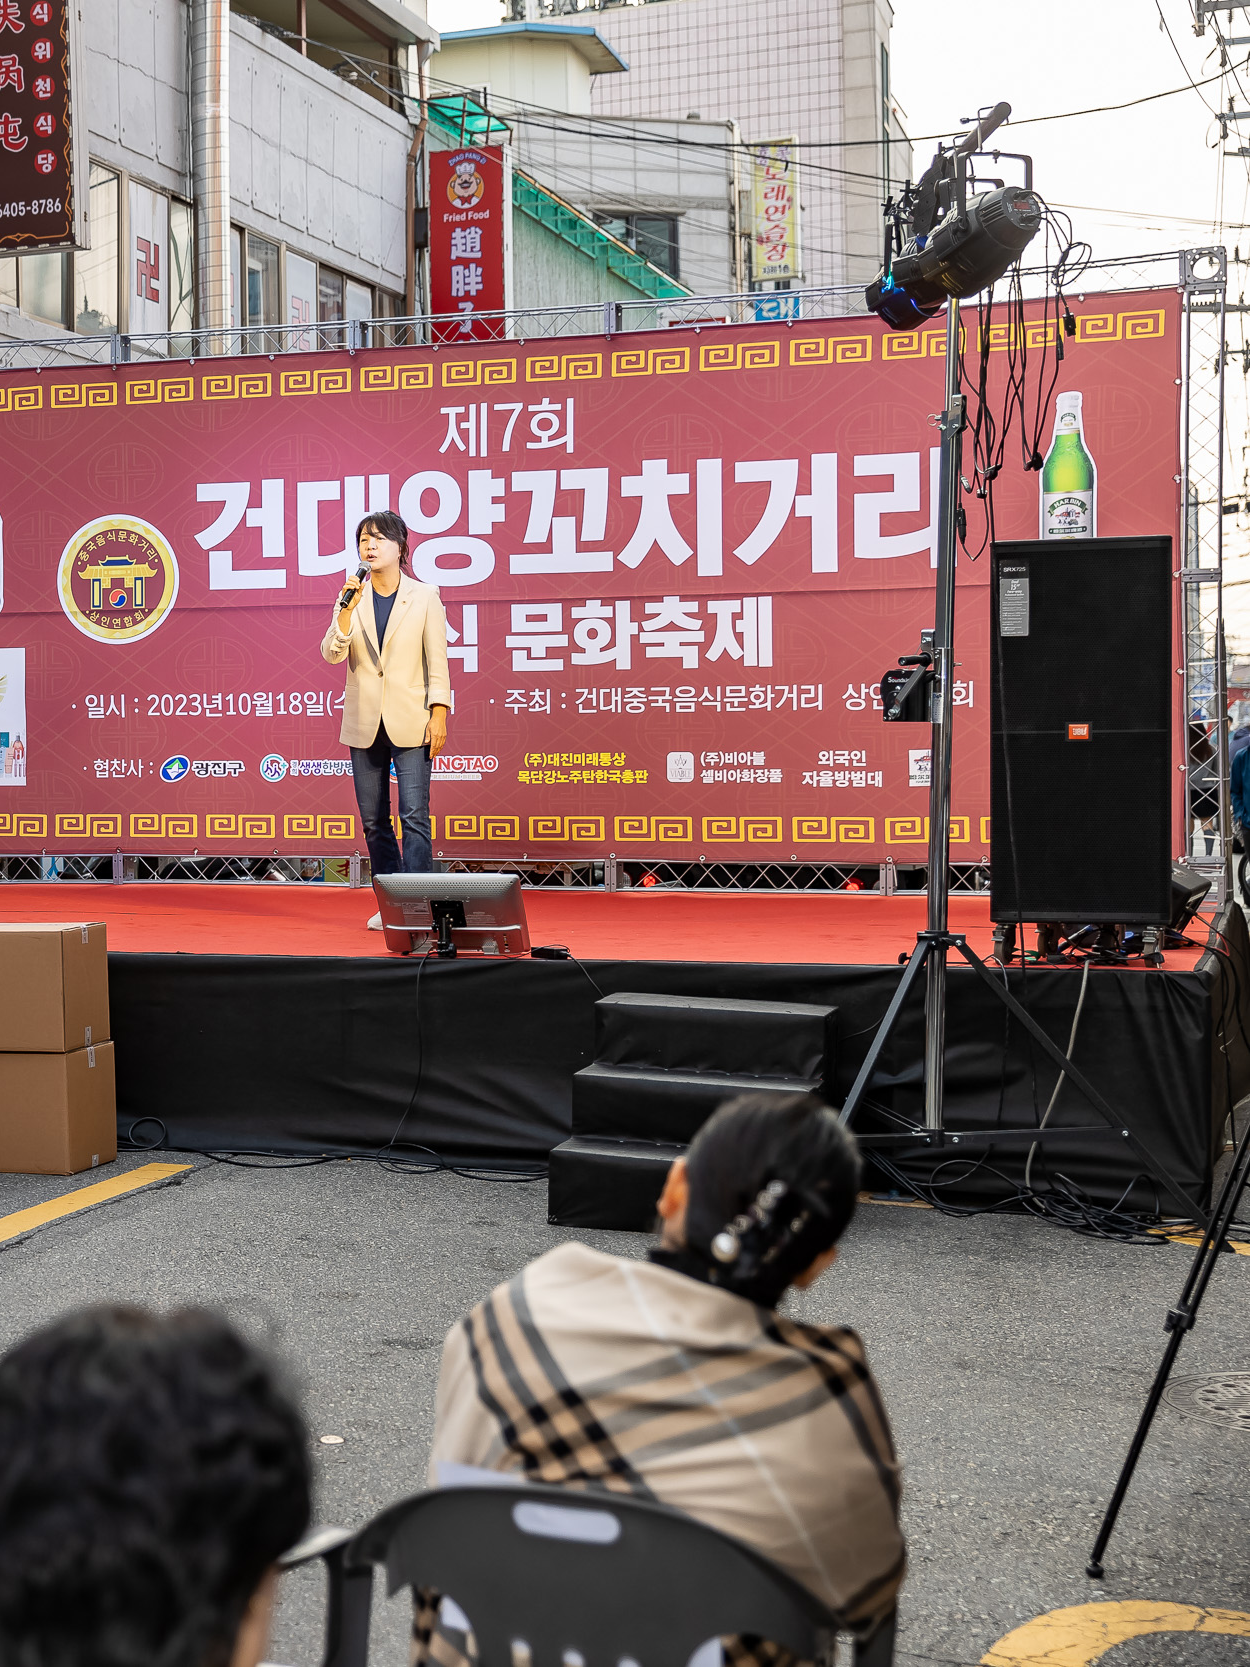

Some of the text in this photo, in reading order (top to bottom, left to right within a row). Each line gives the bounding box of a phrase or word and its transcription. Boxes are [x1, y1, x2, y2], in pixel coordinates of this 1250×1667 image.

[31, 3, 53, 174] 식위천식당
[444, 209, 490, 223] Fried Food
[438, 397, 576, 458] 제7회
[193, 446, 957, 590] 건대양꼬치거리
[89, 609, 145, 628] 상인연합회
[446, 595, 774, 673] 식 문화축제
[84, 693, 126, 718] 일시
[504, 688, 551, 715] 주최
[574, 684, 824, 715] 건대중국음식문화거리
[524, 752, 627, 767] (주)대진미래통상
[700, 751, 766, 767] (주)비아블
[817, 749, 867, 766] 외국인
[92, 758, 144, 779] 협찬사
[192, 760, 244, 778] 광진구
[801, 770, 883, 788] 자율방범대
